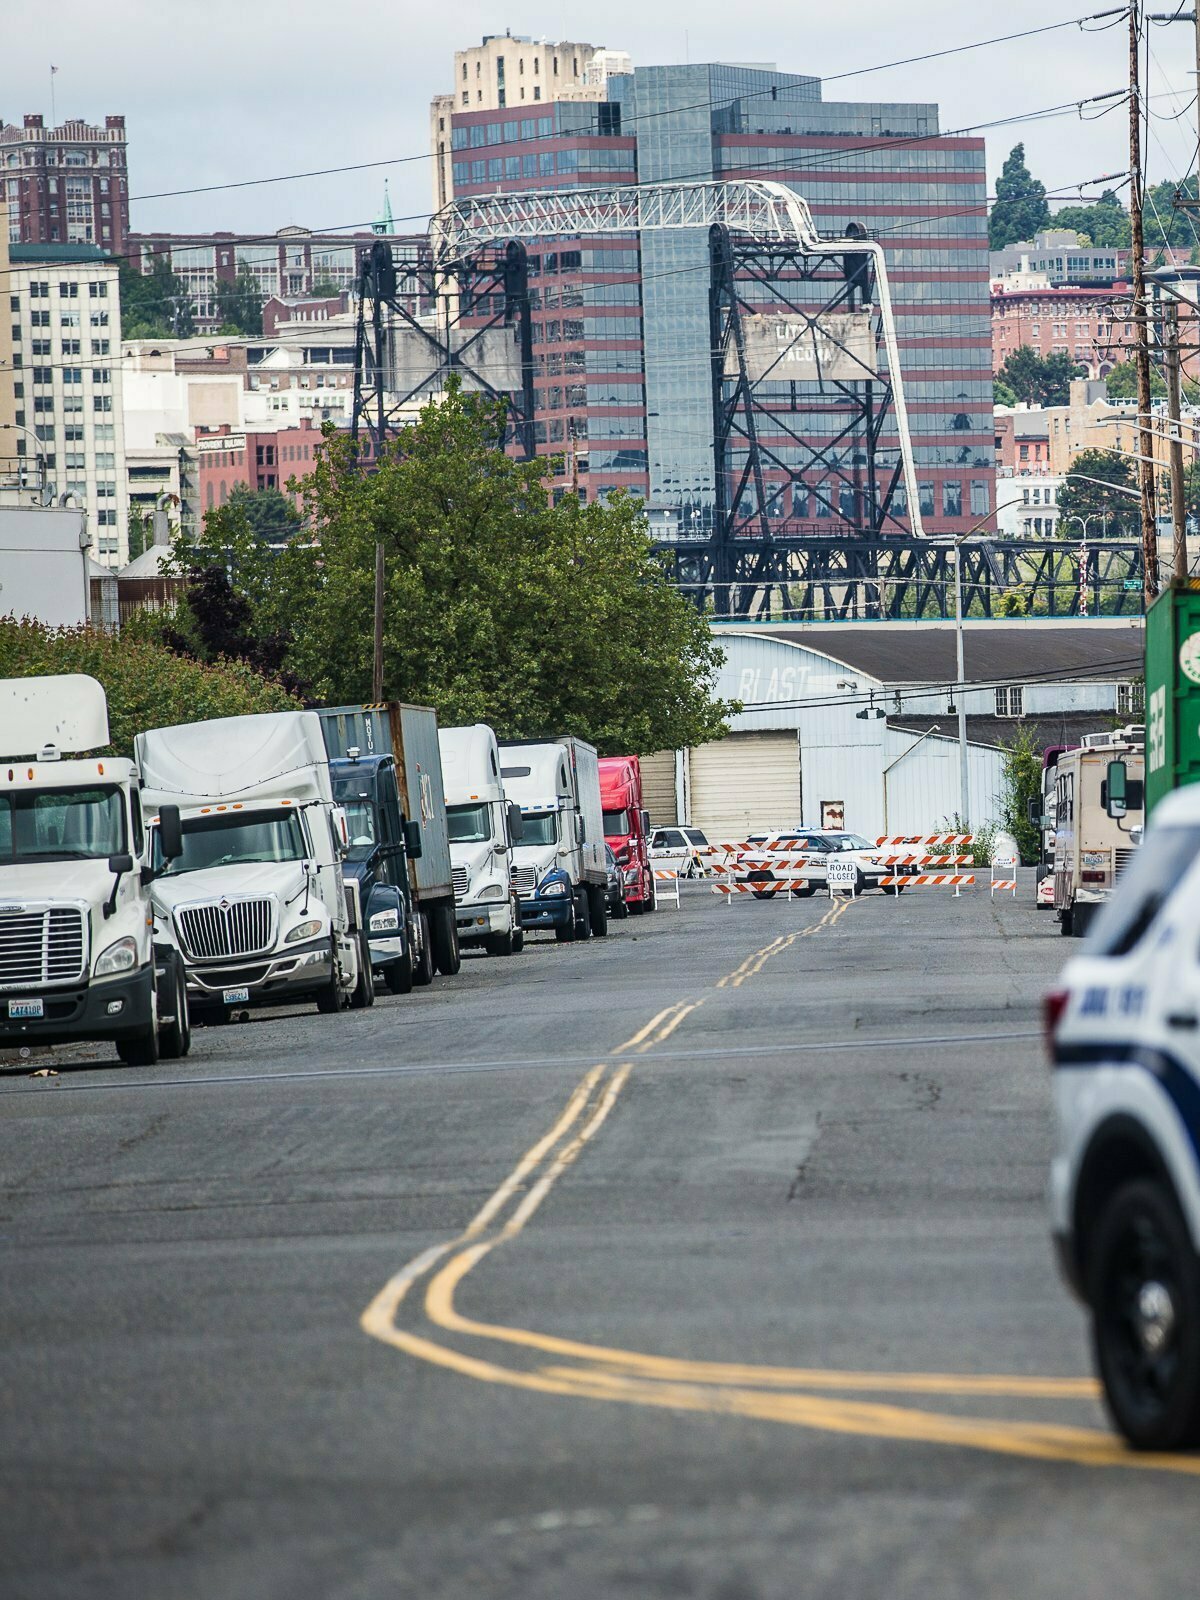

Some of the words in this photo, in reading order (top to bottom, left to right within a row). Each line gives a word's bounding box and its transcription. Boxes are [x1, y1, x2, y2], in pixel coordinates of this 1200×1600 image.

[776, 325, 806, 340] CITY
[738, 666, 812, 703] BLAST
[829, 864, 853, 872] ROAD
[827, 872, 856, 880] CLOSED
